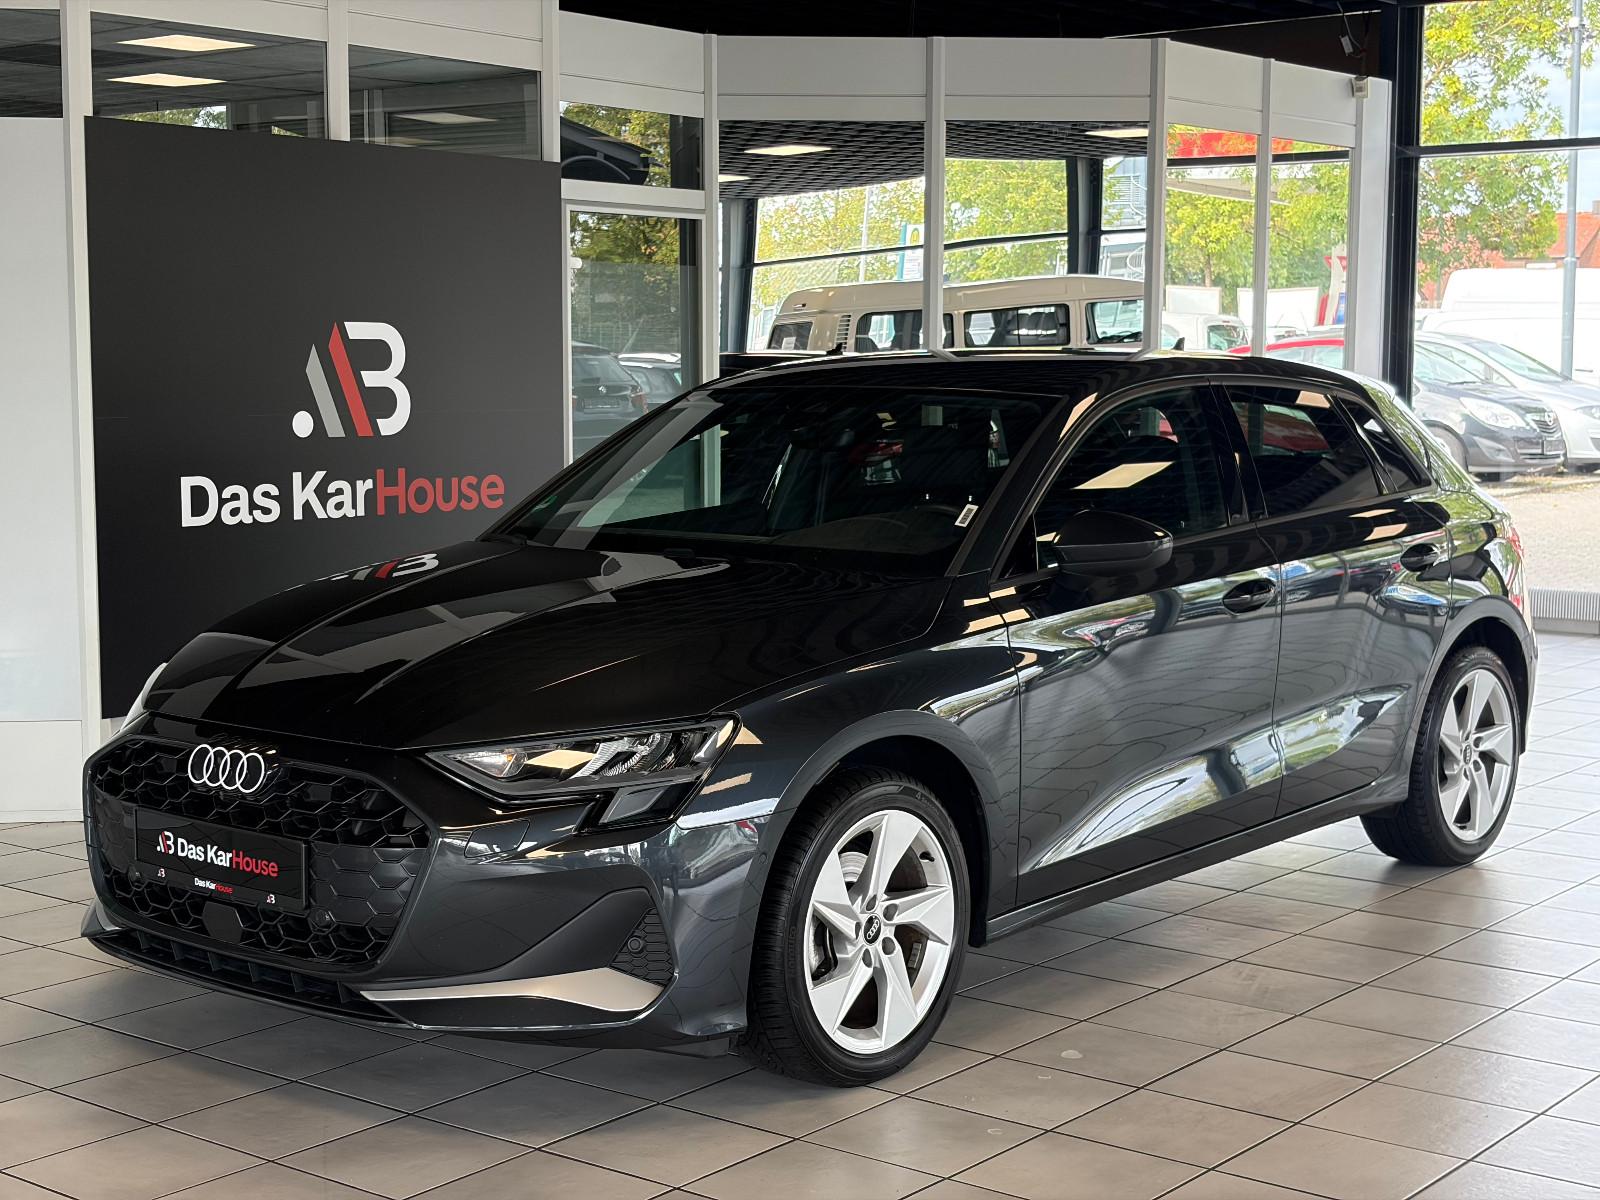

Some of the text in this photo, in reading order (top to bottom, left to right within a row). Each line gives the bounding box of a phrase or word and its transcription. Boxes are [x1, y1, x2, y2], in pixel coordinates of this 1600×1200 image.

[180, 475, 280, 528] Das
[177, 837, 204, 862] Das
[194, 877, 206, 888] Das
